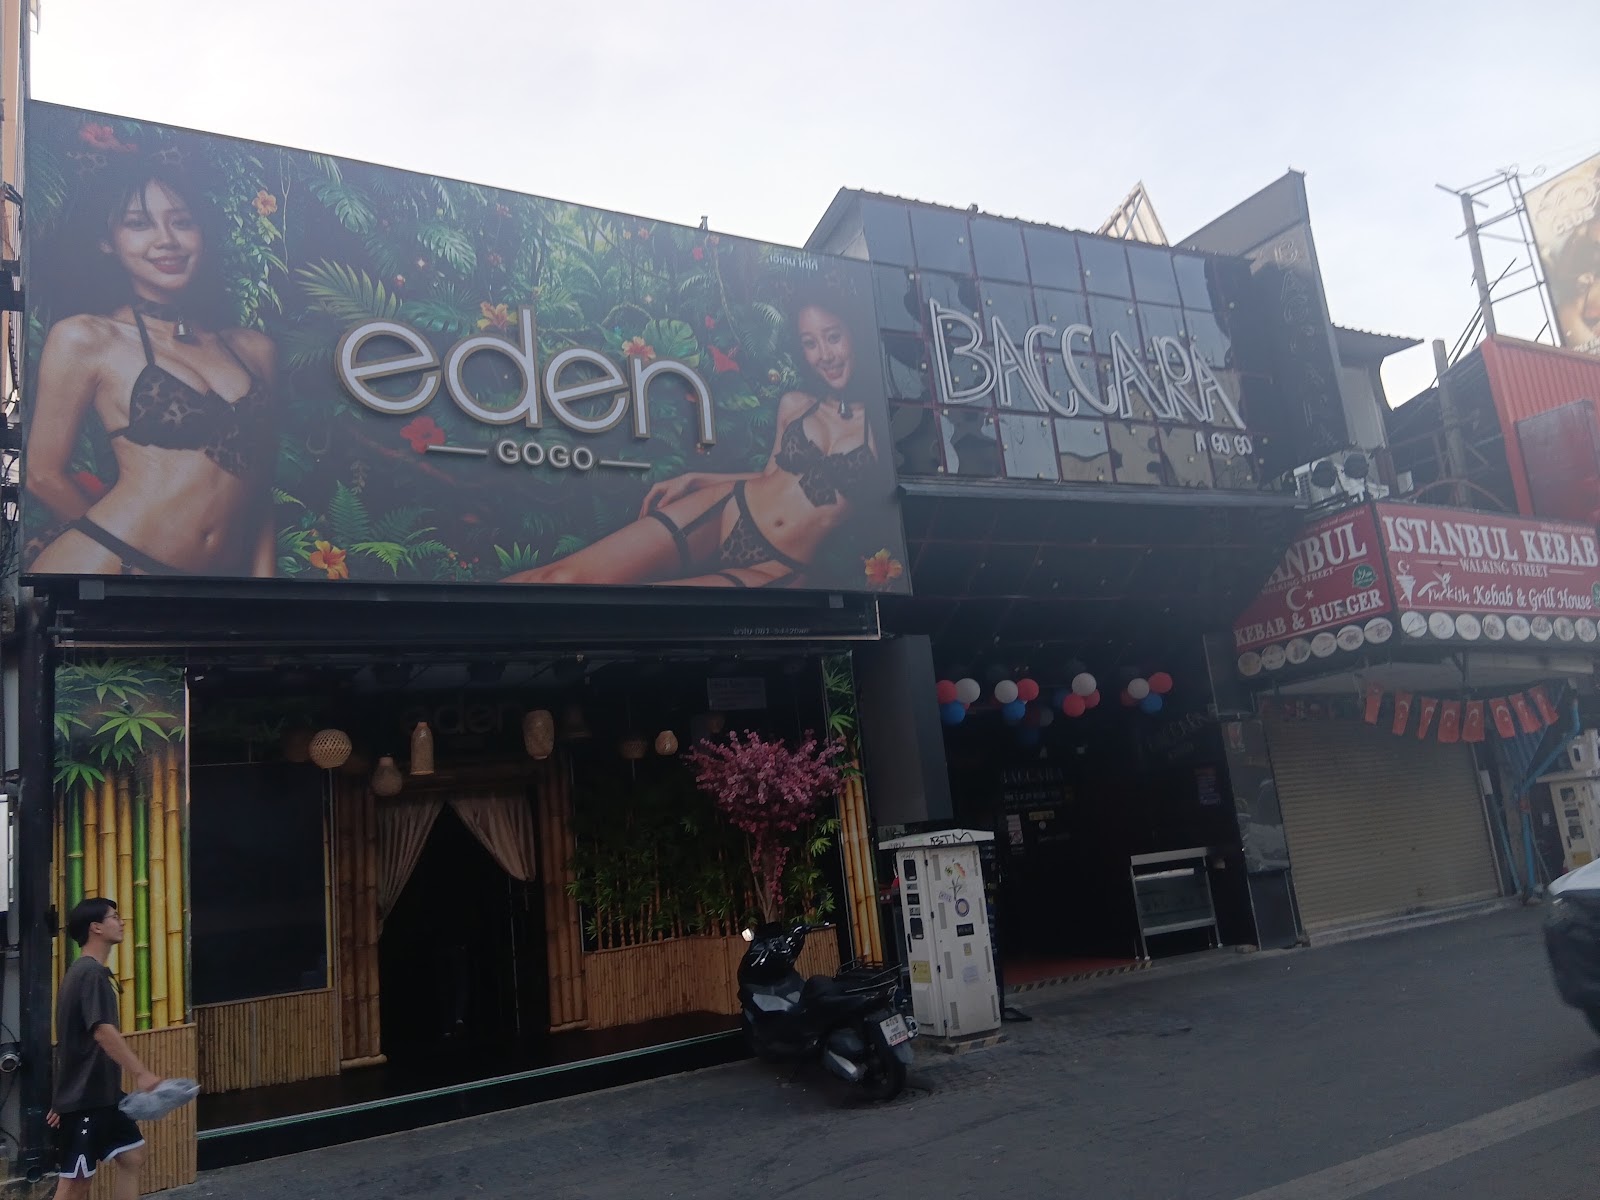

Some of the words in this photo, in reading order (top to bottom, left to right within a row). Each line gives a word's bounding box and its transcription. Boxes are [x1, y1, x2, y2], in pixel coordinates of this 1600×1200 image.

[335, 304, 716, 445] eden
[929, 297, 1247, 430] BACCARA
[498, 440, 597, 471] GOGO
[1211, 432, 1230, 454] GO
[1233, 434, 1252, 455] GO
[1264, 522, 1367, 587] ANBUL
[1382, 515, 1519, 562] ISTANBUL
[1520, 530, 1599, 567] KEBAB
[1459, 558, 1510, 576] WALKING
[1511, 564, 1549, 579] STREET
[1417, 572, 1470, 603] Turkish
[1473, 584, 1514, 607] Kebab
[1517, 590, 1527, 608] &
[1528, 586, 1557, 612] Grill
[1557, 589, 1592, 610] House
[1233, 616, 1287, 647] KEBAB
[1292, 612, 1306, 631] &
